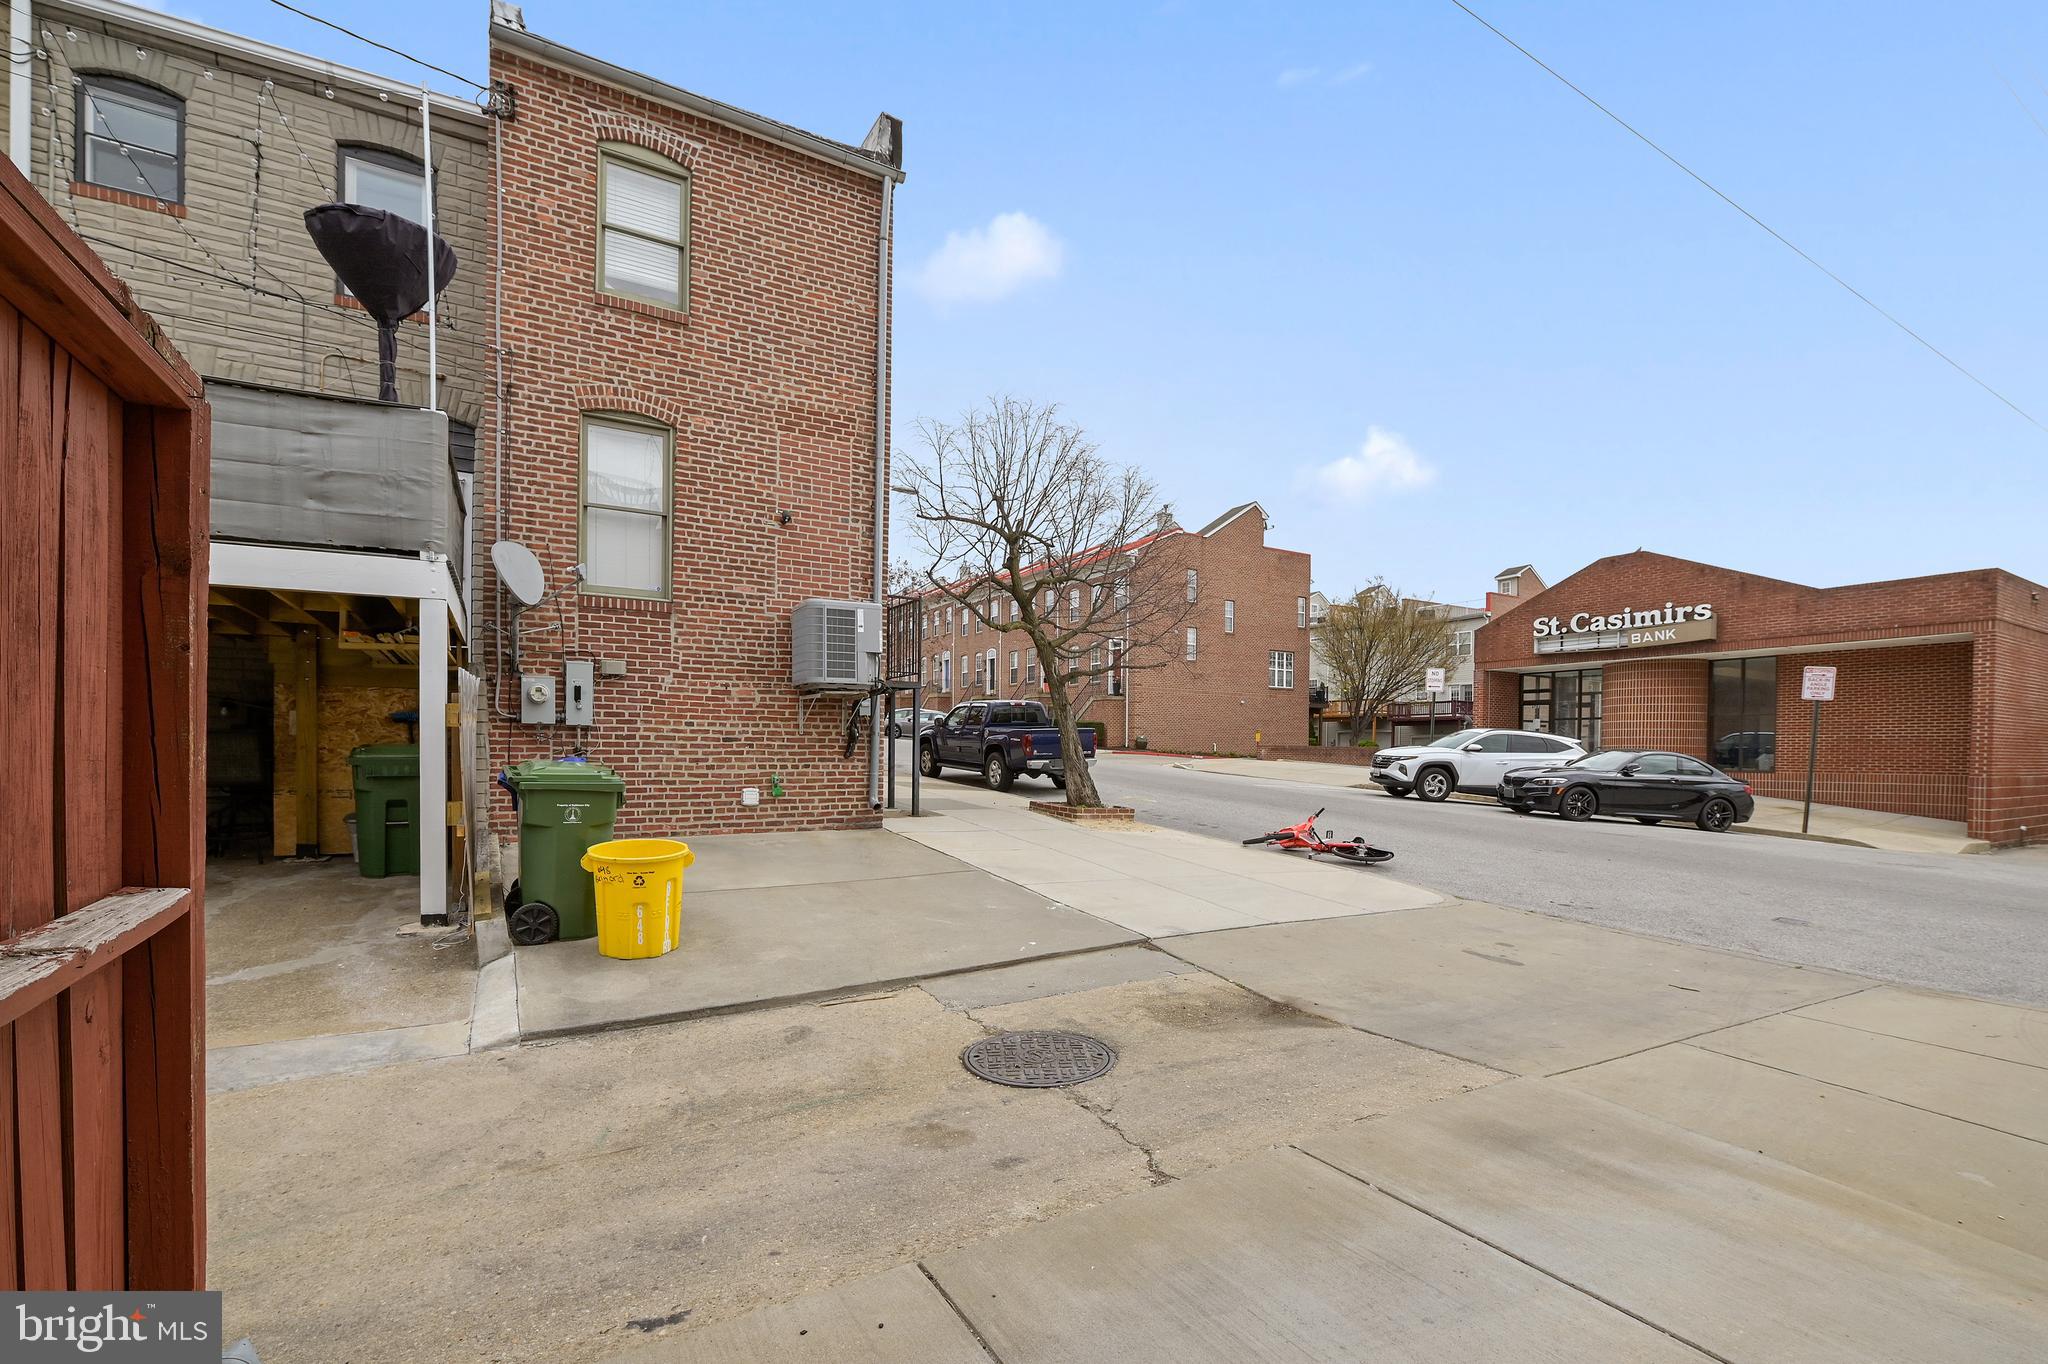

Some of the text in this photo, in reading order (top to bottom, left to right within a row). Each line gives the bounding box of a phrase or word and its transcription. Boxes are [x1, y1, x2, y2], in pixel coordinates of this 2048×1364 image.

[1533, 602, 1712, 637] St. Casimirs
[1631, 628, 1676, 644] BANK
